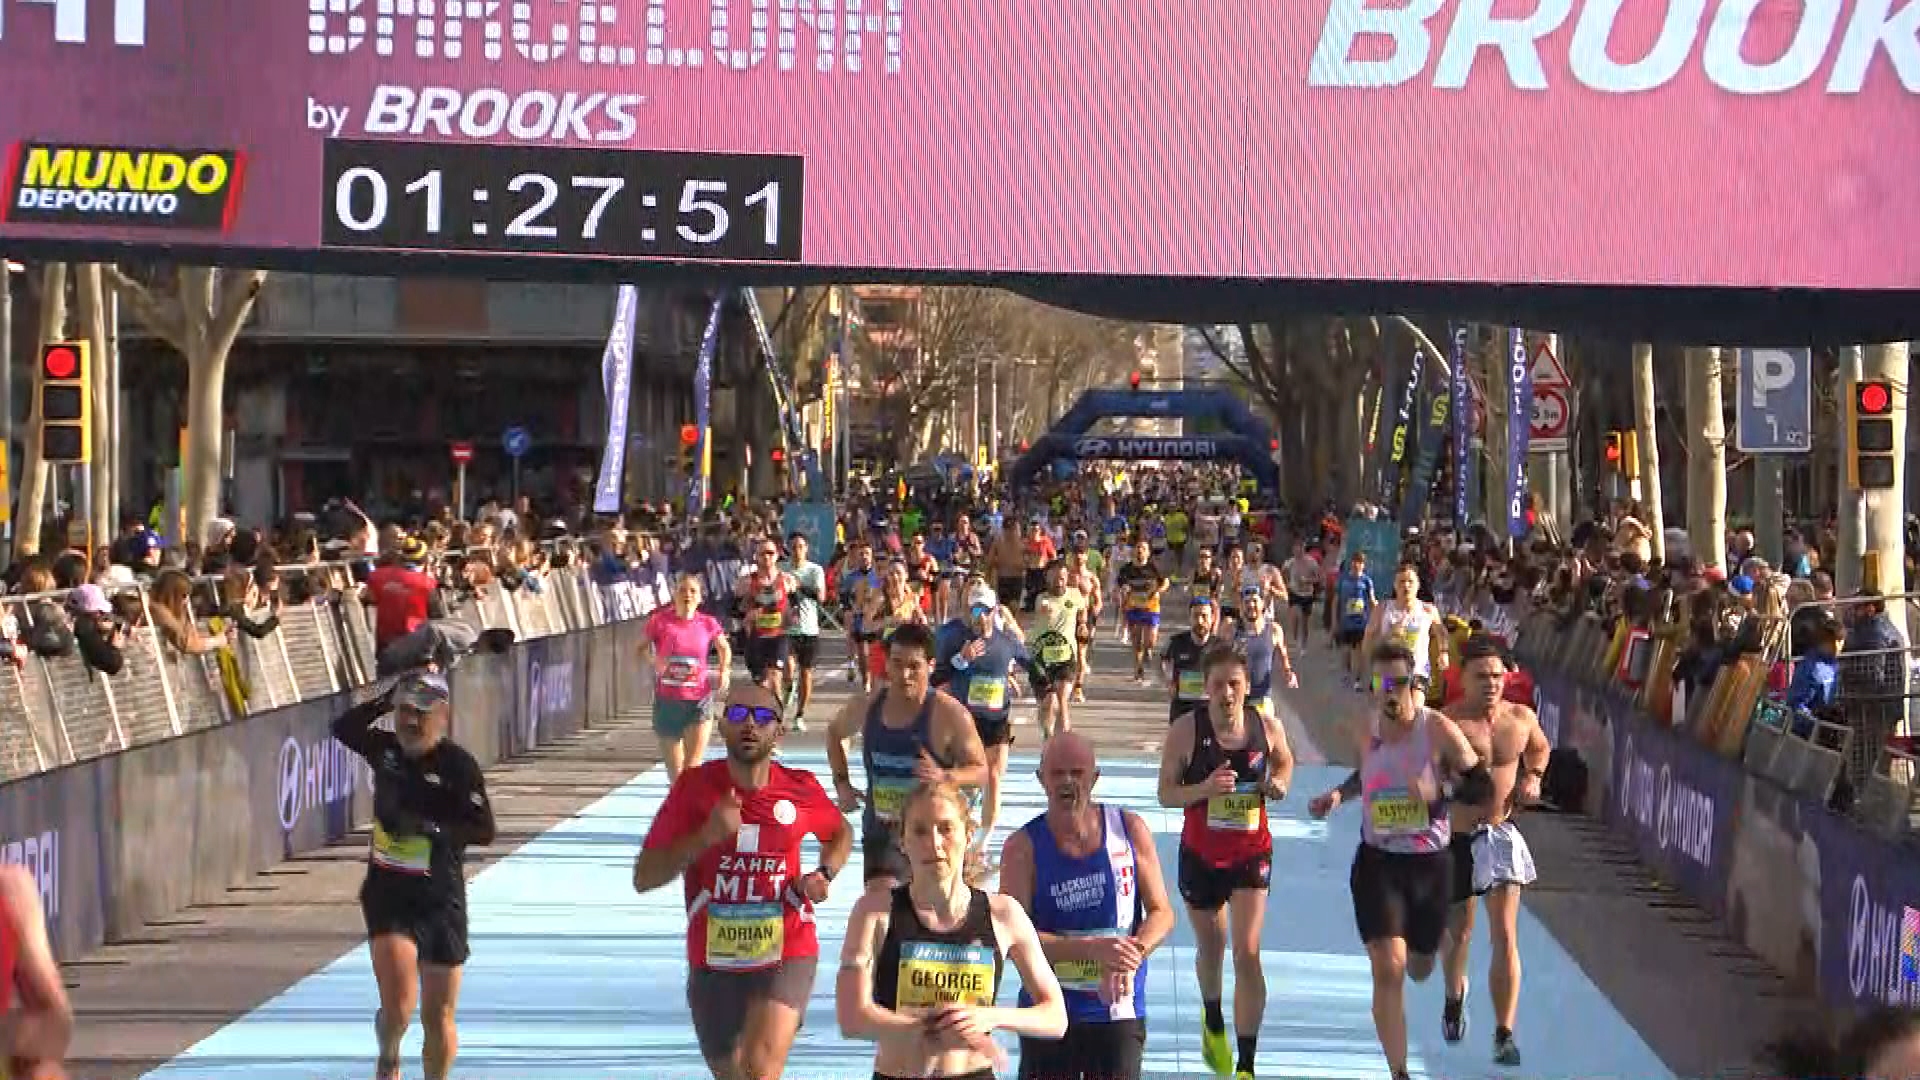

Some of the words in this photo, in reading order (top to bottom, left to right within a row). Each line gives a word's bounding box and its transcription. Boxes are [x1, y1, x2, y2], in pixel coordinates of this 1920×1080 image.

[306, 97, 350, 137] by
[364, 84, 648, 141] BROOKS
[23, 147, 229, 194] MUNDO
[17, 188, 178, 216] DEPORTIVO
[334, 166, 783, 245] 01:27:51
[1751, 350, 1796, 408] P
[1118, 441, 1217, 456] HYUNDAI
[1671, 780, 1714, 871] HYUNDAI
[718, 855, 787, 873] ZAHRA
[713, 873, 787, 902] MLT
[1050, 872, 1107, 897] BLACKBURN
[717, 925, 774, 941] ADRIAN
[911, 968, 984, 992] GEORGE
